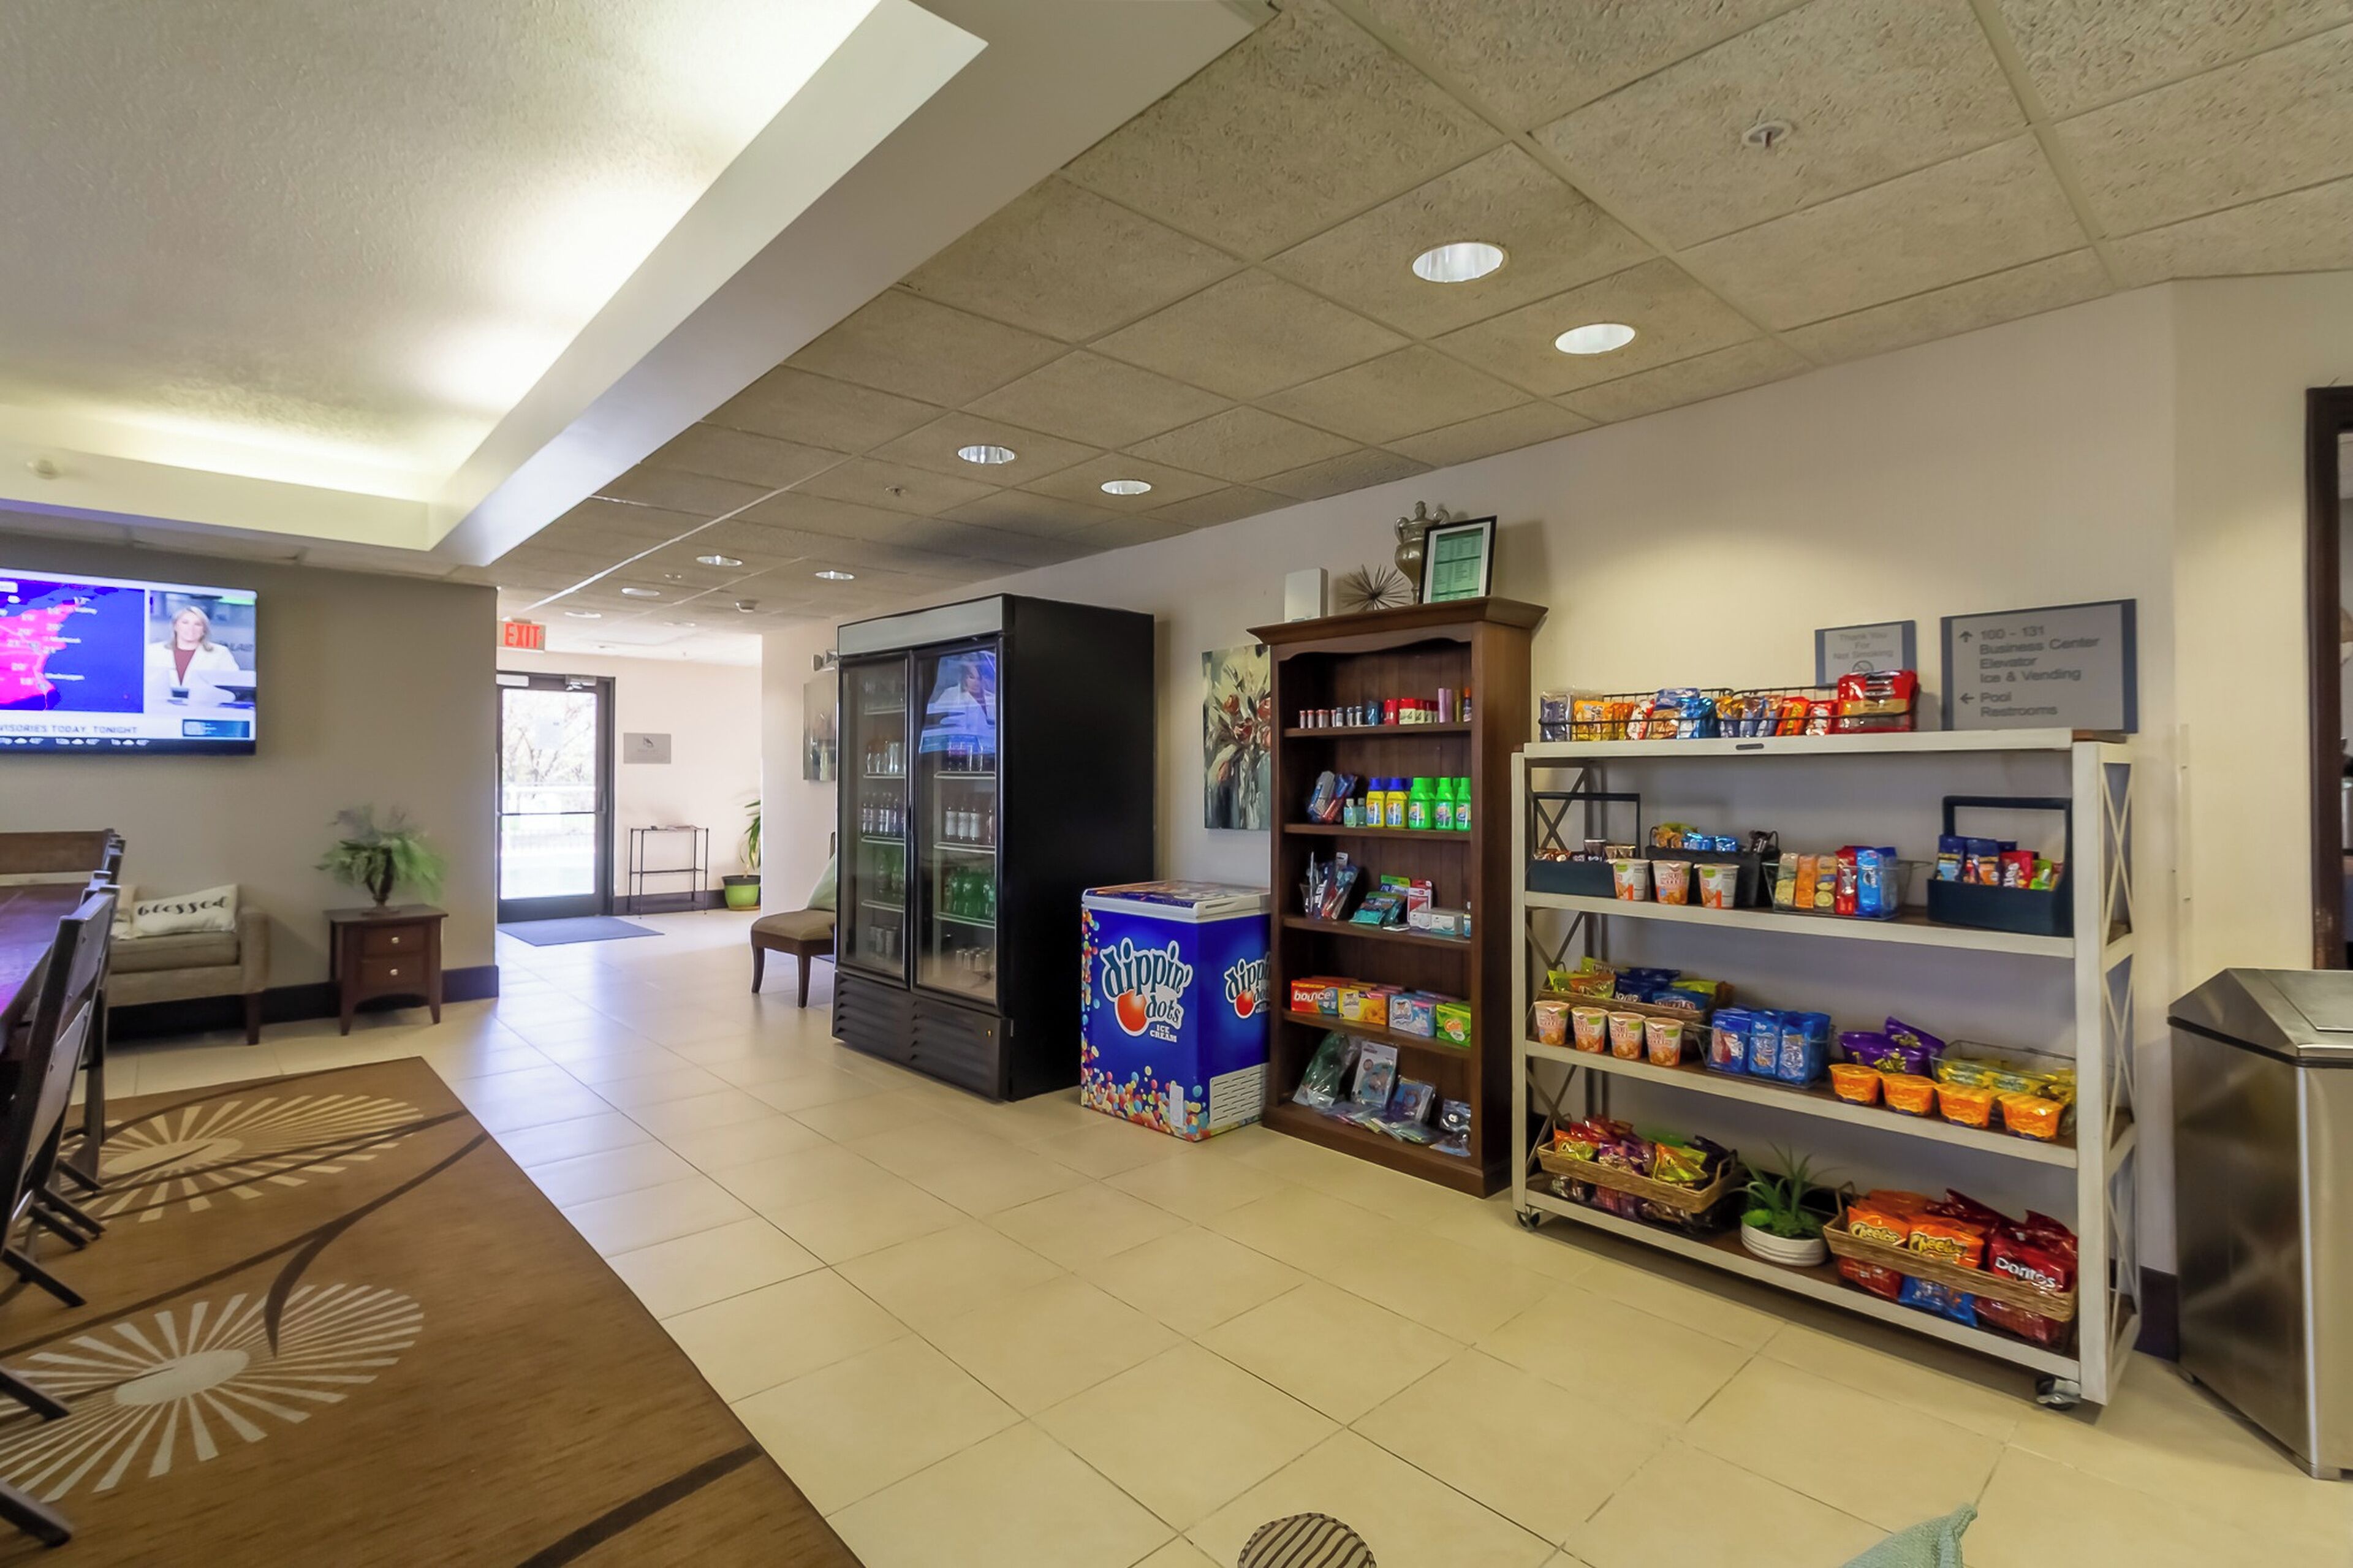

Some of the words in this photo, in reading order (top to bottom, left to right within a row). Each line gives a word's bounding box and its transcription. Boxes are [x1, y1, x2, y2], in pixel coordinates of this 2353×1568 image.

[504, 623, 540, 649] EXIT
[1980, 629, 2005, 640] 100
[2022, 626, 2044, 637] 131
[1979, 642, 2044, 655] Business
[2049, 637, 2100, 650] Center
[1979, 657, 2038, 670] Elevator
[1980, 673, 2001, 683] Ice
[2006, 672, 2017, 682] &
[2020, 668, 2082, 681] Vending
[1980, 691, 2012, 703] Pool
[1980, 706, 2058, 717] Restrooms
[138, 896, 227, 915] blessed
[1224, 952, 1271, 1001] dippi
[1294, 990, 1331, 1002] bounce
[1145, 994, 1181, 1023] dots
[1150, 1029, 1177, 1042] CREAM
[1156, 1024, 1170, 1033] ICE
[1995, 1256, 2056, 1288] Doritos
